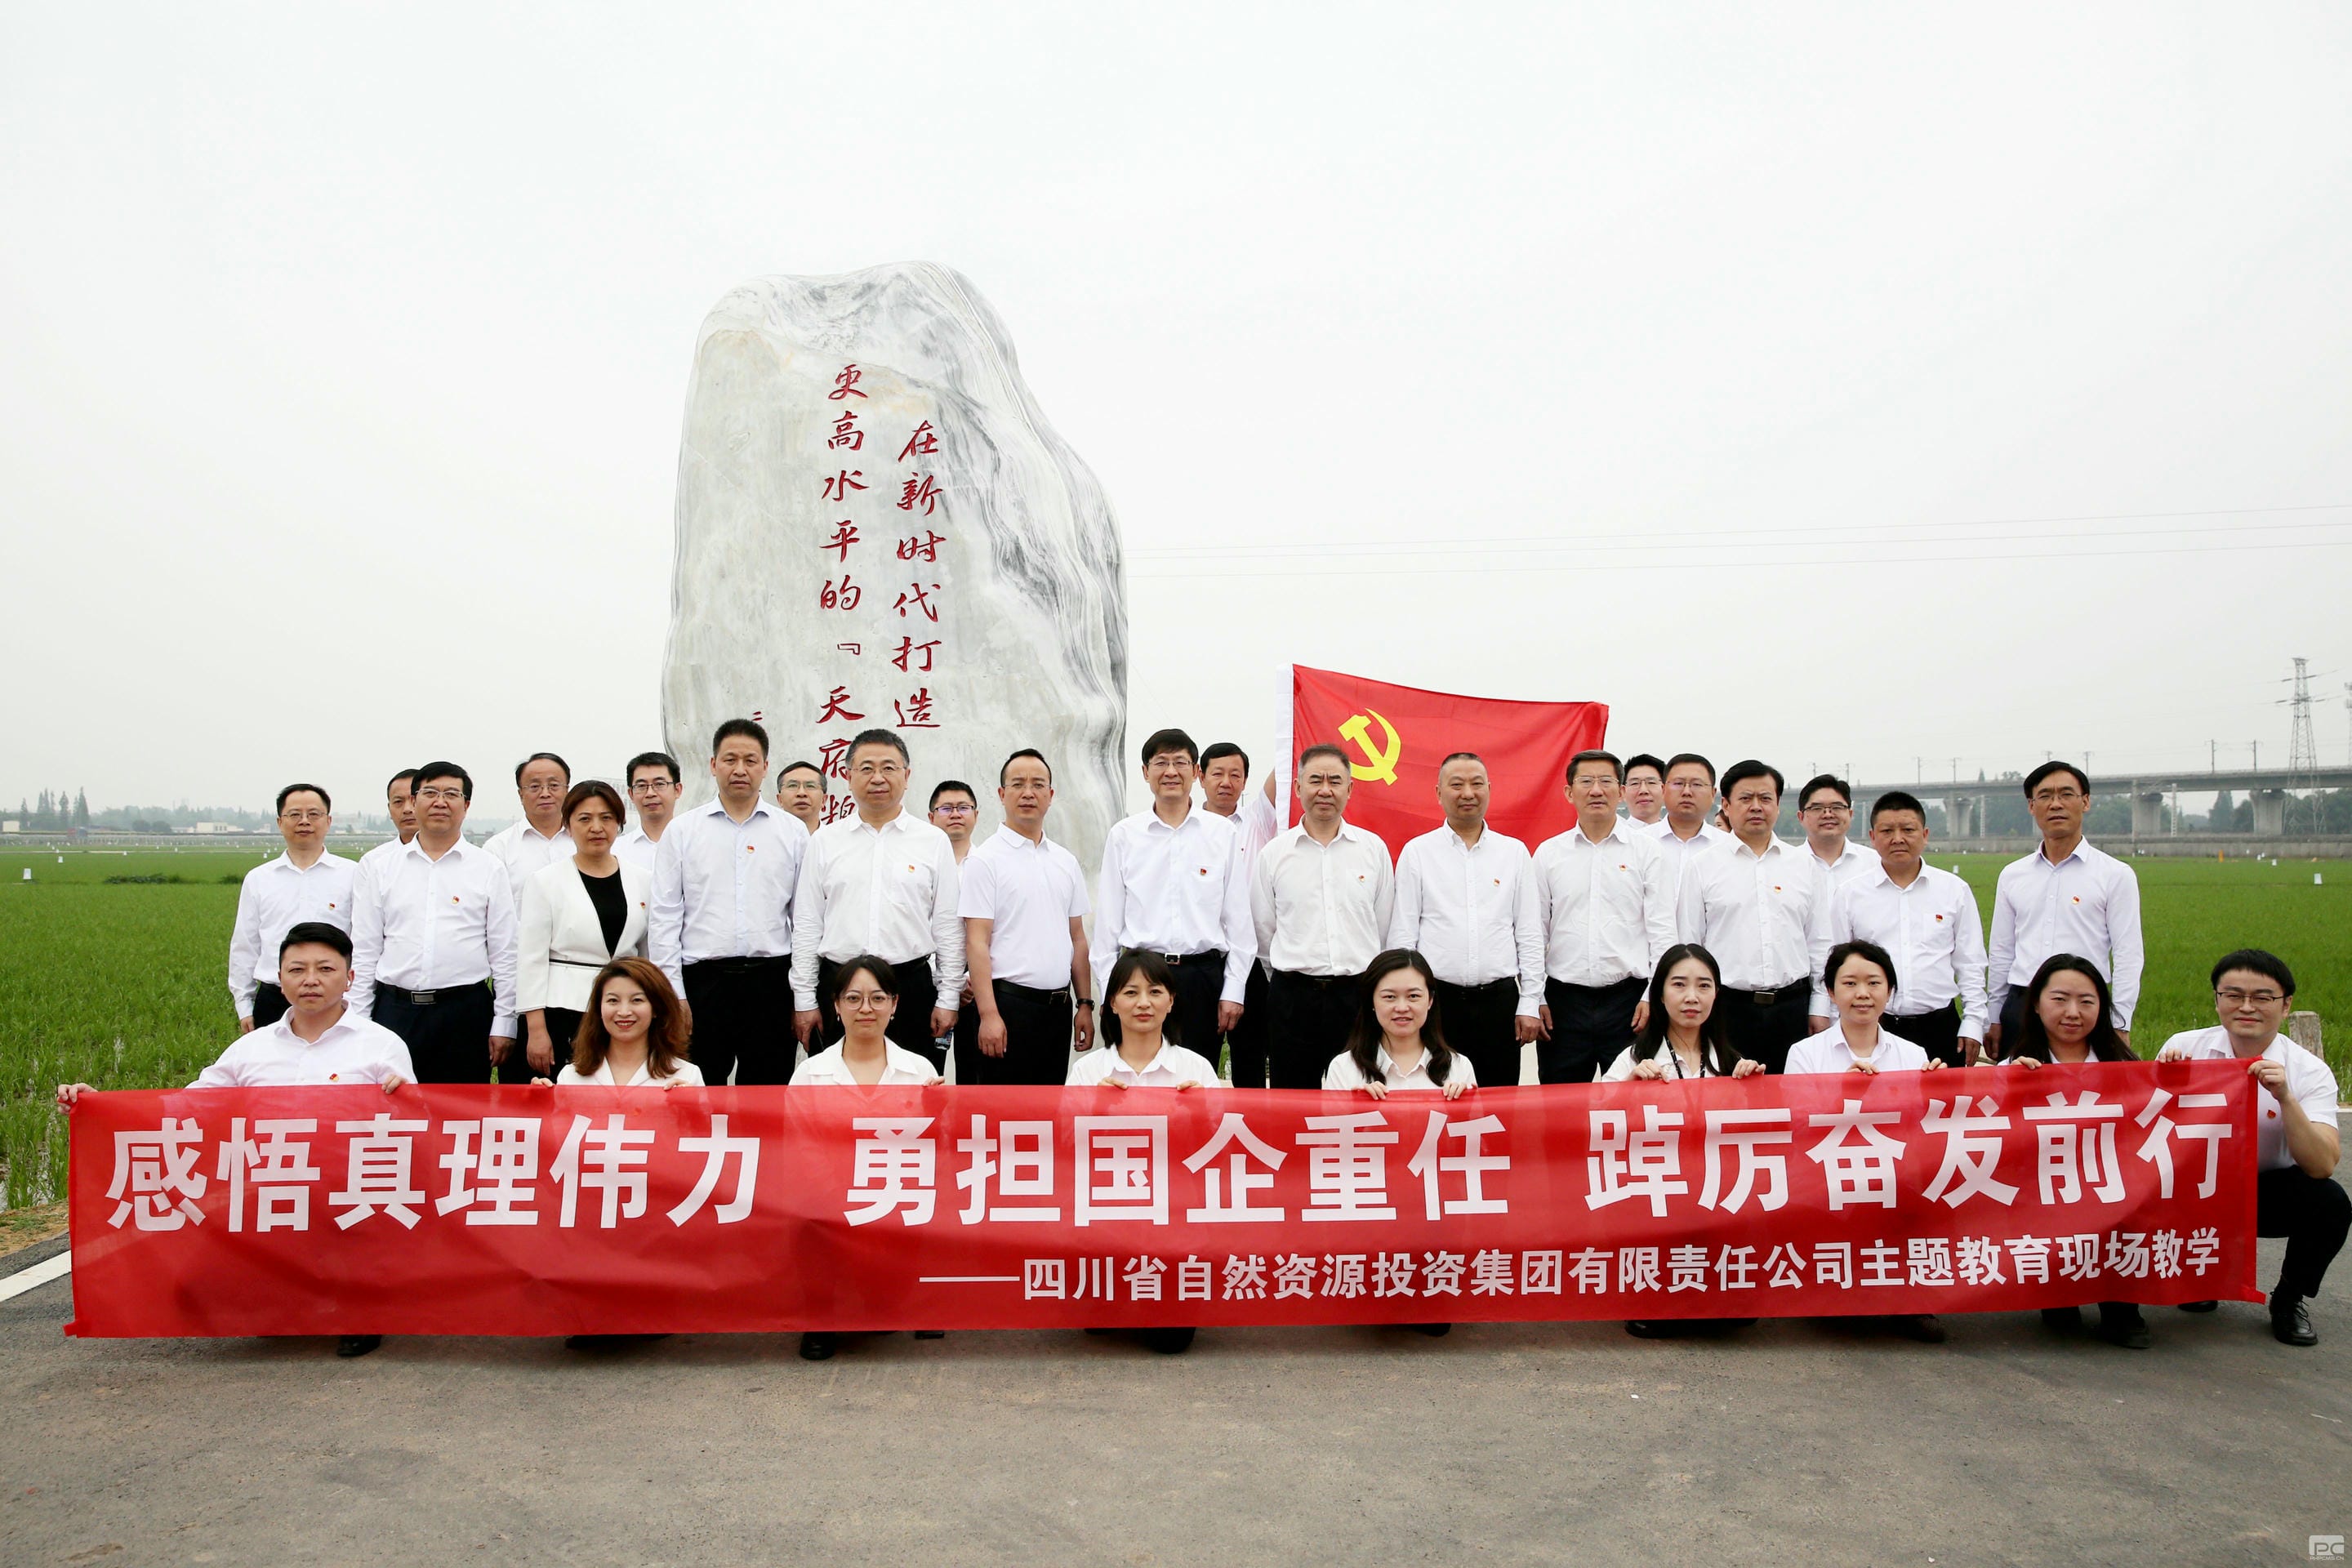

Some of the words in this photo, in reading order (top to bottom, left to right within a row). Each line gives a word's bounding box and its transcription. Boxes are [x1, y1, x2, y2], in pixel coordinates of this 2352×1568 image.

[892, 421, 947, 728] 在新时代打造
[105, 1112, 762, 1233] 感悟真理伟力
[844, 1109, 1512, 1227] 勇担国企重任
[1584, 1088, 2234, 1218] 踔厉奋发前行
